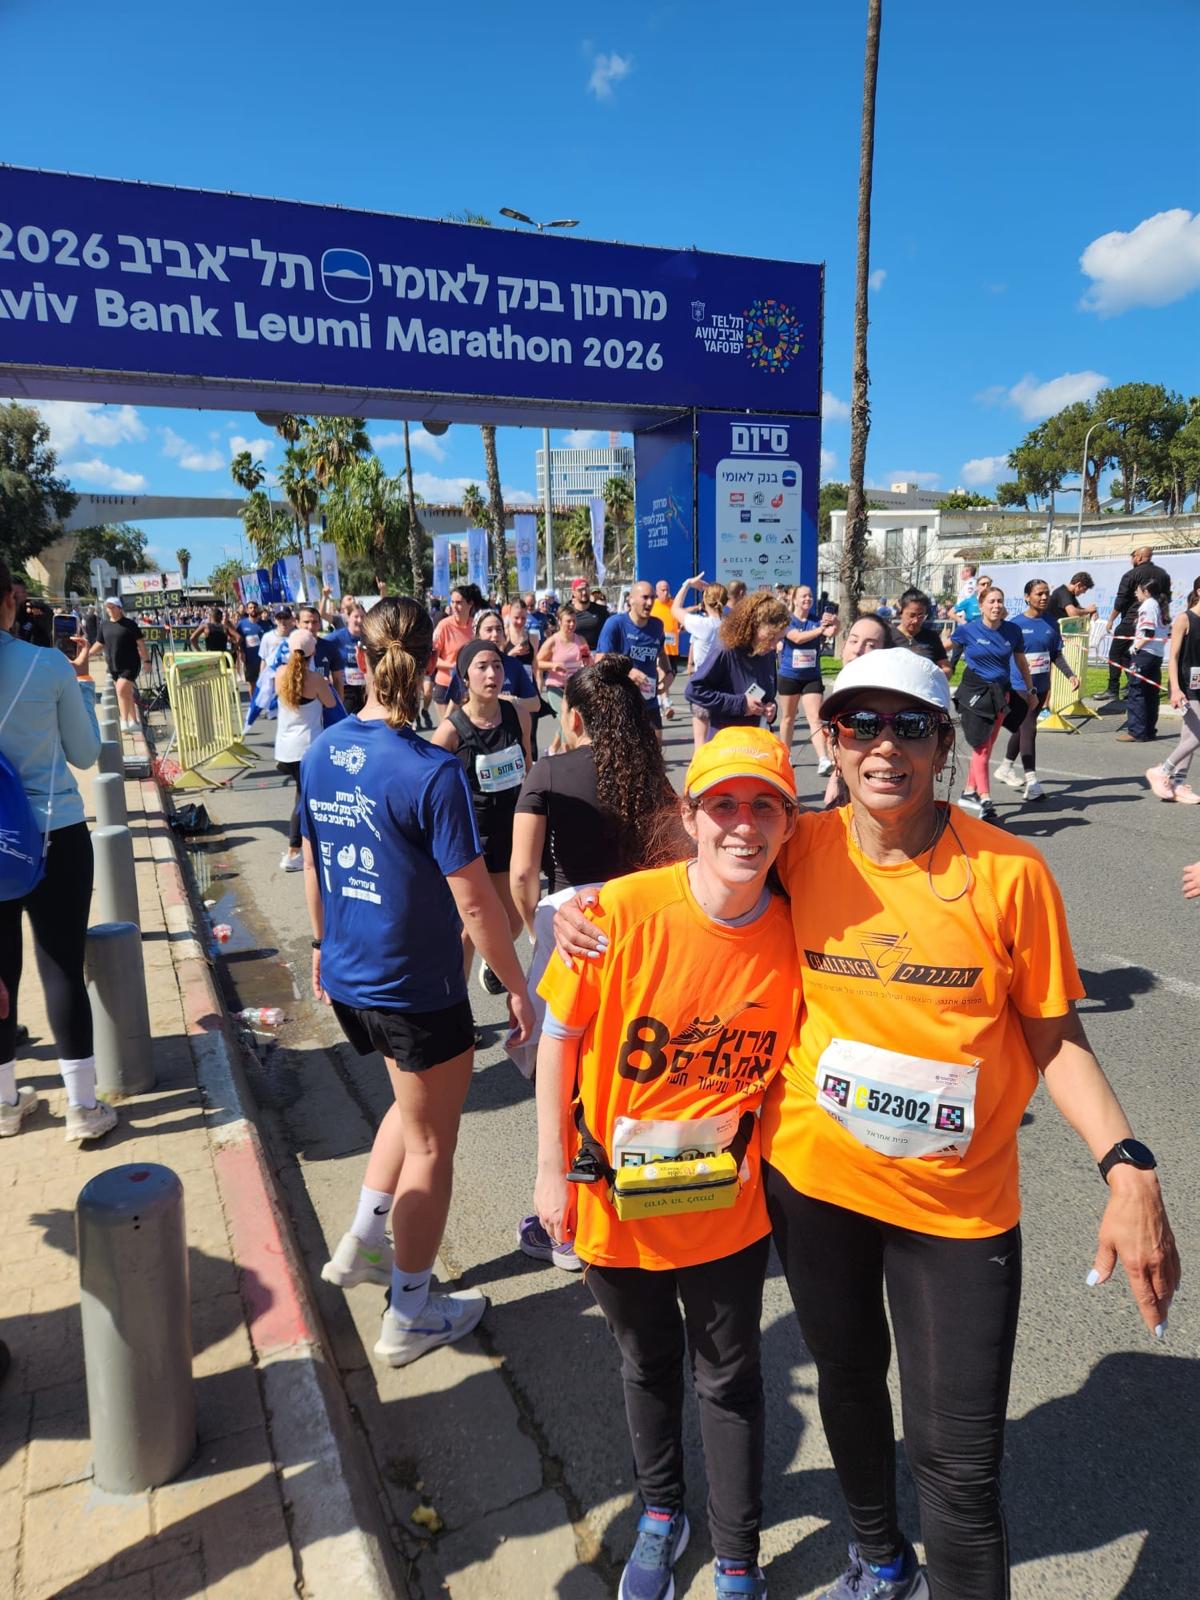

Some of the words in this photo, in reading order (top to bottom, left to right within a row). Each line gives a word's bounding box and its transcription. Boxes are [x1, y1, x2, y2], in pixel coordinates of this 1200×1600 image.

[378, 262, 489, 306] לאומי
[498, 275, 565, 315] בנק
[570, 282, 668, 322] מרתון
[94, 287, 223, 338] Bank
[234, 301, 372, 350] Leumi
[385, 316, 573, 365] Marathon
[583, 338, 664, 373] 2026
[711, 315, 729, 328] TEL
[729, 313, 744, 329] תל
[695, 327, 719, 340] AVIV
[718, 329, 744, 342] אביב
[704, 340, 729, 353] YAFO
[729, 342, 744, 354] יפו
[732, 426, 788, 452] סיום
[722, 471, 754, 482] לאומי
[758, 472, 778, 485] בנק
[809, 953, 876, 977] CHALLENGE
[898, 965, 974, 986] אתגרים
[618, 1016, 670, 1084] 8
[718, 1025, 777, 1056] מרוץ
[670, 1049, 771, 1083] אתגרים
[697, 1075, 731, 1094] שניאור
[854, 1084, 931, 1124] C52302
